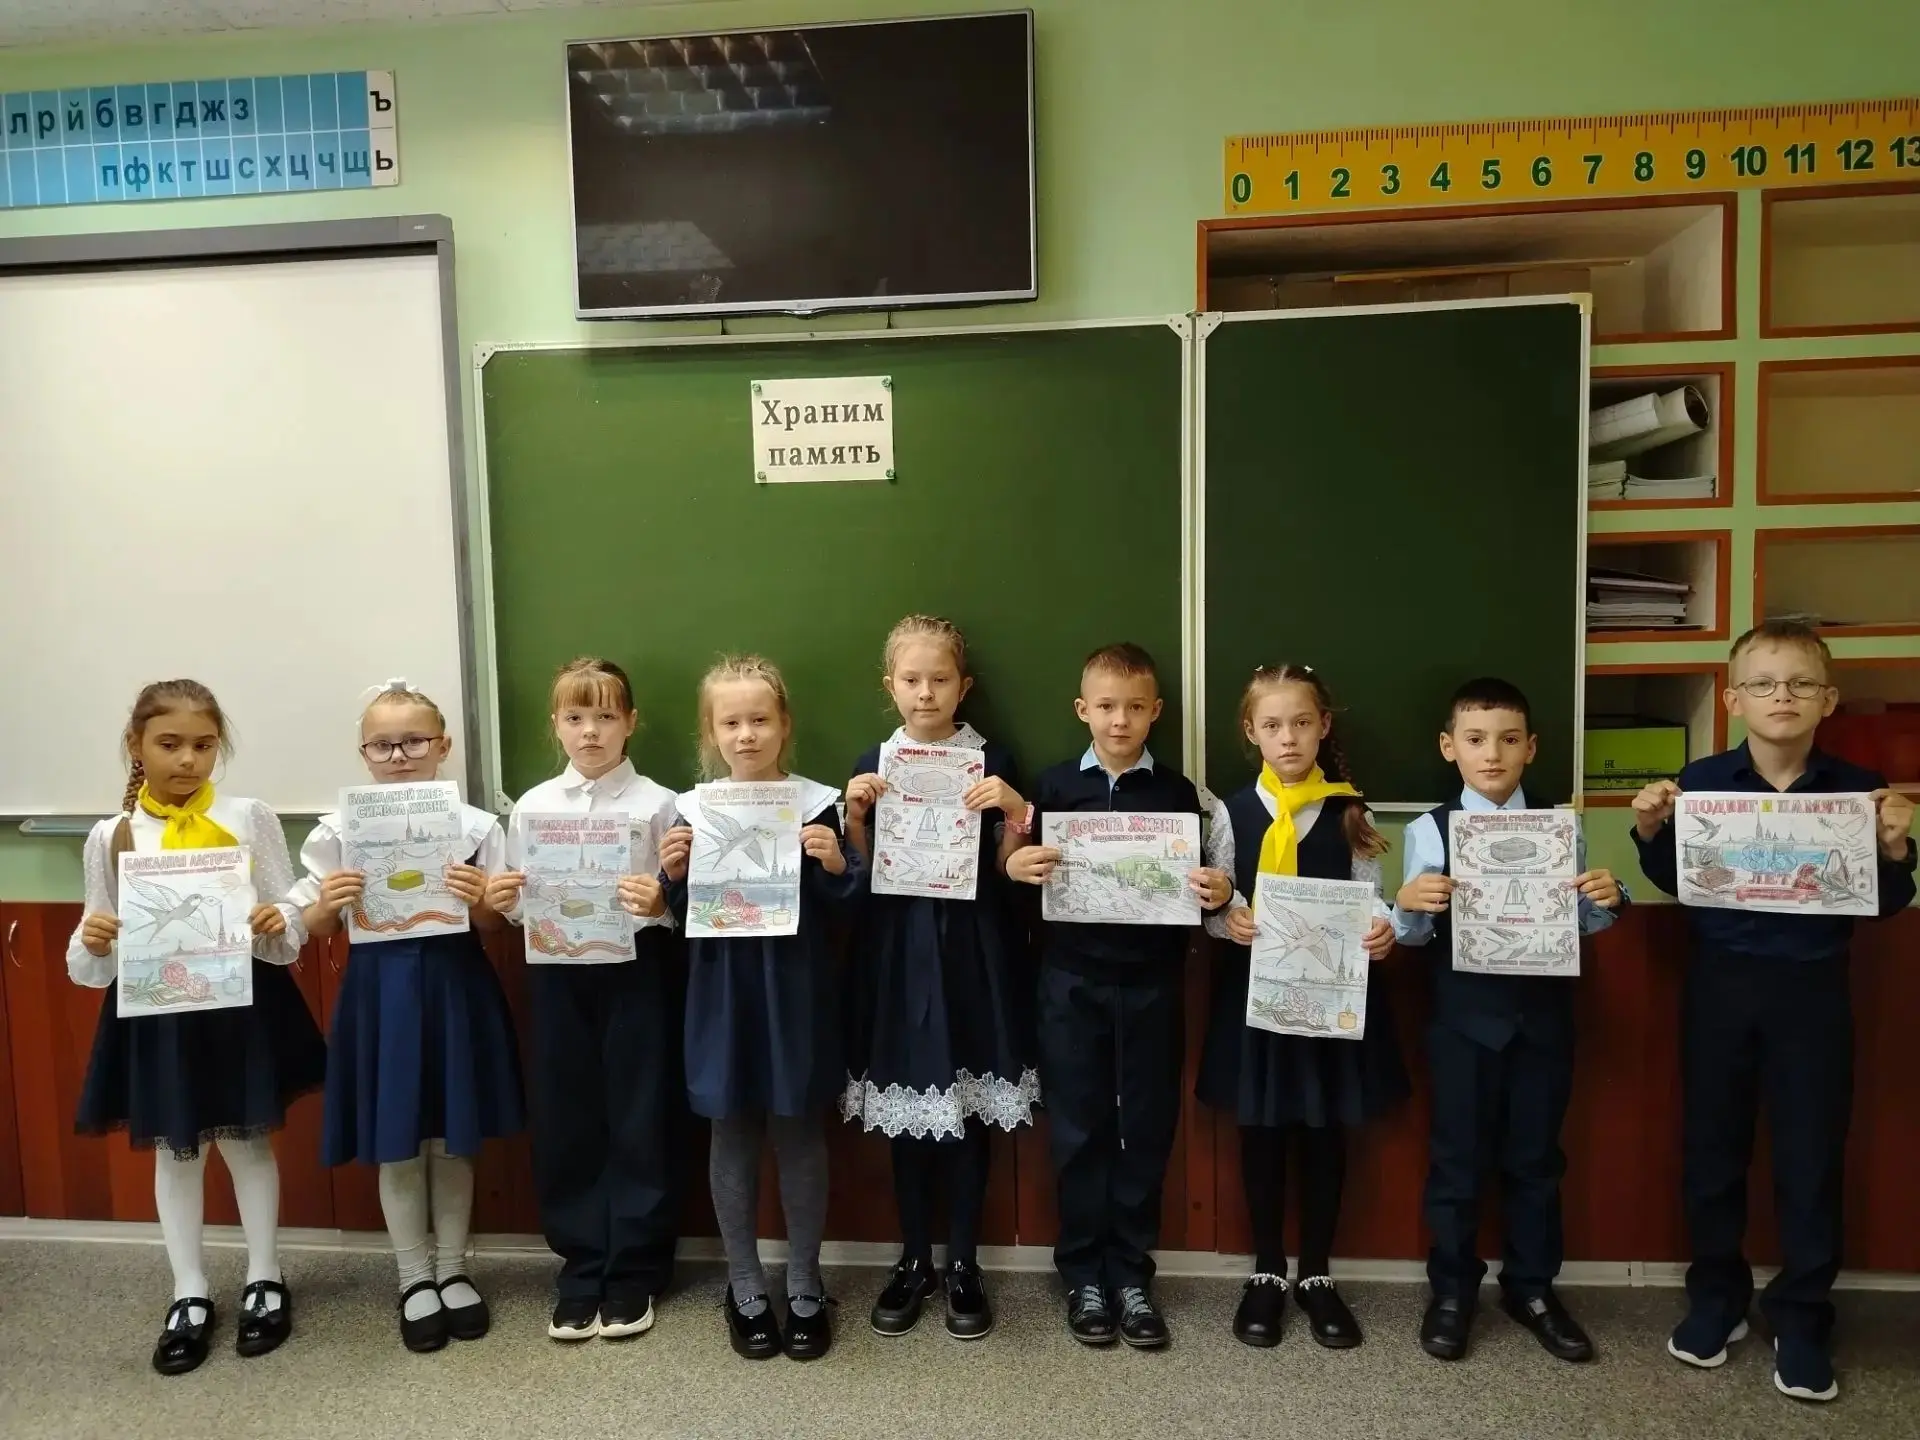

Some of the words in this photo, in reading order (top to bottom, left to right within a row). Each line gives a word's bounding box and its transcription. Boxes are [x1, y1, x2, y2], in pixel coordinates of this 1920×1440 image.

[1232, 173, 1251, 203] 0
[1284, 170, 1300, 201] 1
[1331, 168, 1351, 198] 2
[1380, 164, 1400, 195] 3
[1430, 162, 1450, 192] 4
[1481, 159, 1501, 189] 5
[1531, 156, 1552, 187] 6
[1583, 154, 1603, 185] 7
[1634, 151, 1654, 182] 8
[1685, 149, 1706, 180] 9
[1730, 145, 1767, 177] 10
[1784, 142, 1816, 174] 11
[1836, 139, 1874, 171] 12
[1888, 135, 1920, 168] 13
[761, 399, 885, 431] Храним
[769, 445, 881, 467] память
[347, 788, 415, 806] БЛОКАДНЫЙ
[1684, 799, 1759, 815] ПОДВИГ
[1777, 798, 1865, 815] ПАМЯТЬ
[357, 803, 406, 818] СИМВОЛ
[408, 800, 449, 814] ЖИЗНИ
[1066, 816, 1125, 839] ДОРОГА
[1128, 815, 1184, 835] ЖИЗНИ
[190, 850, 243, 867] ЛАСТОЧКА
